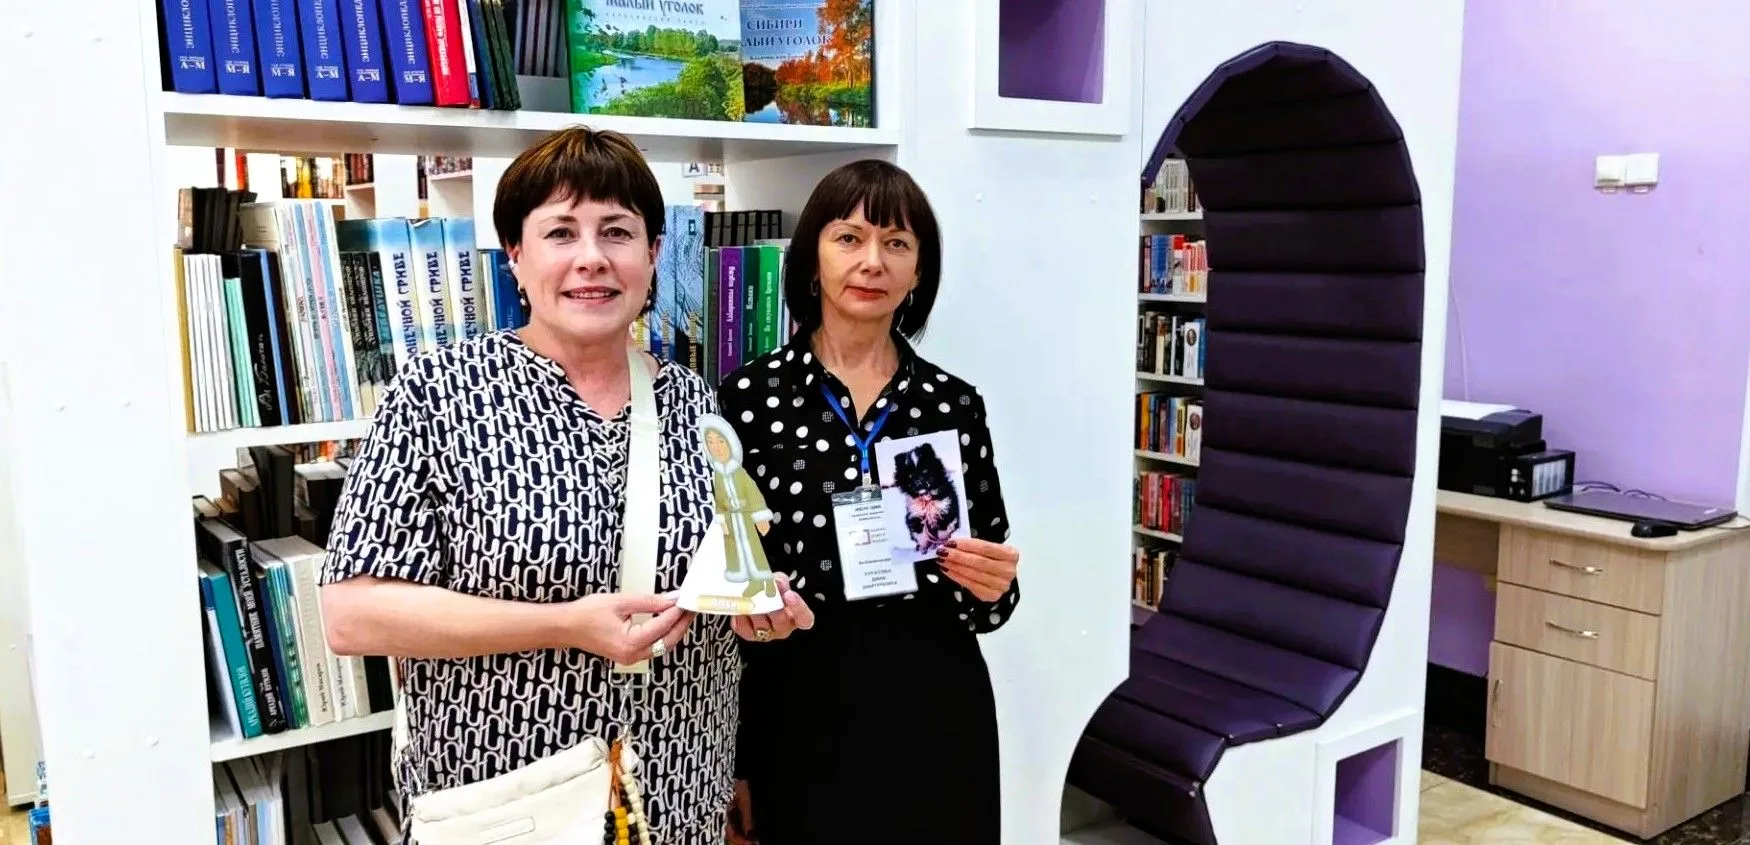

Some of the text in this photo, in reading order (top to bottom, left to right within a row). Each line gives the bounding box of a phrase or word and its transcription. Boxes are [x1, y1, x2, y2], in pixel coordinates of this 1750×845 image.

[746, 18, 804, 30] СИБИРИ
[778, 34, 832, 46] УГОЛОК
[393, 252, 409, 295] ГРИВЕ
[426, 251, 441, 293] ГРИВЕ
[458, 250, 473, 292] ГРИВЕ
